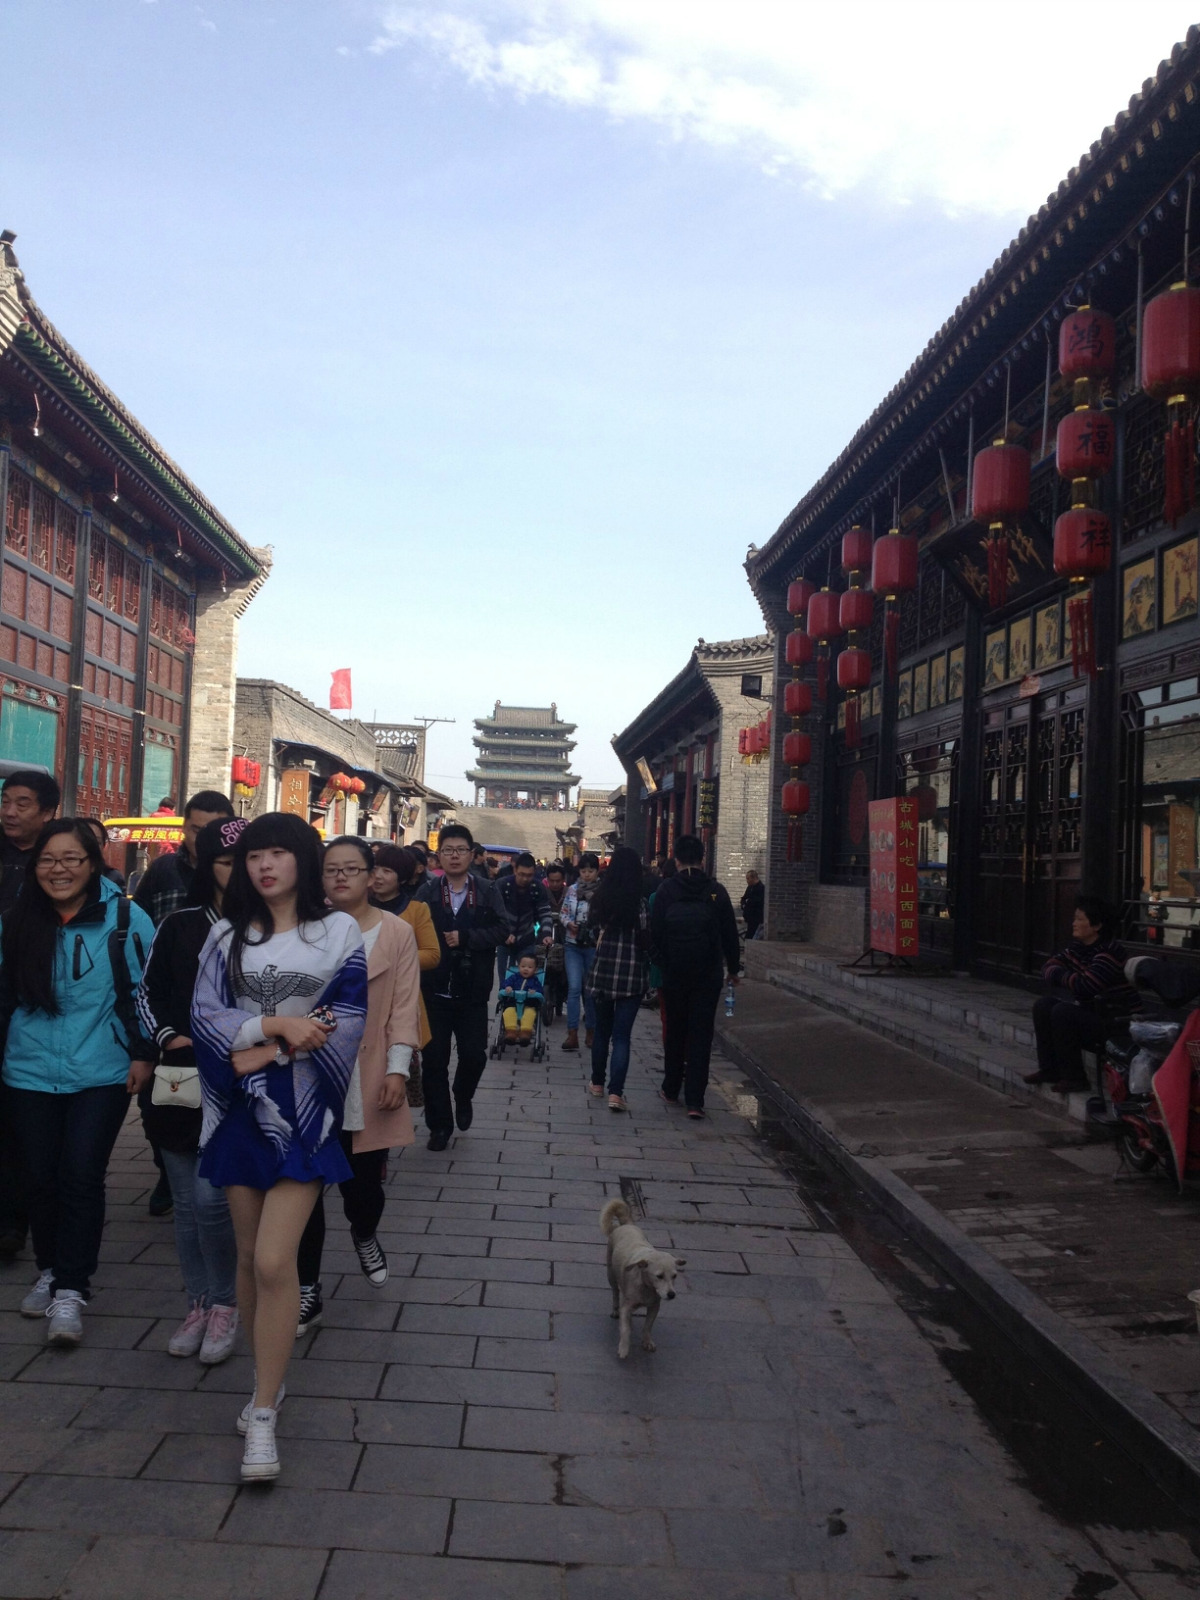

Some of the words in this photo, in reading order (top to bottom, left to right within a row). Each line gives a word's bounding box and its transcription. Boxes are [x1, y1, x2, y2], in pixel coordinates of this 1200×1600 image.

[220, 832, 240, 848] LO
[899, 803, 915, 867] 古城小吃
[899, 883, 915, 947] 山西面食
